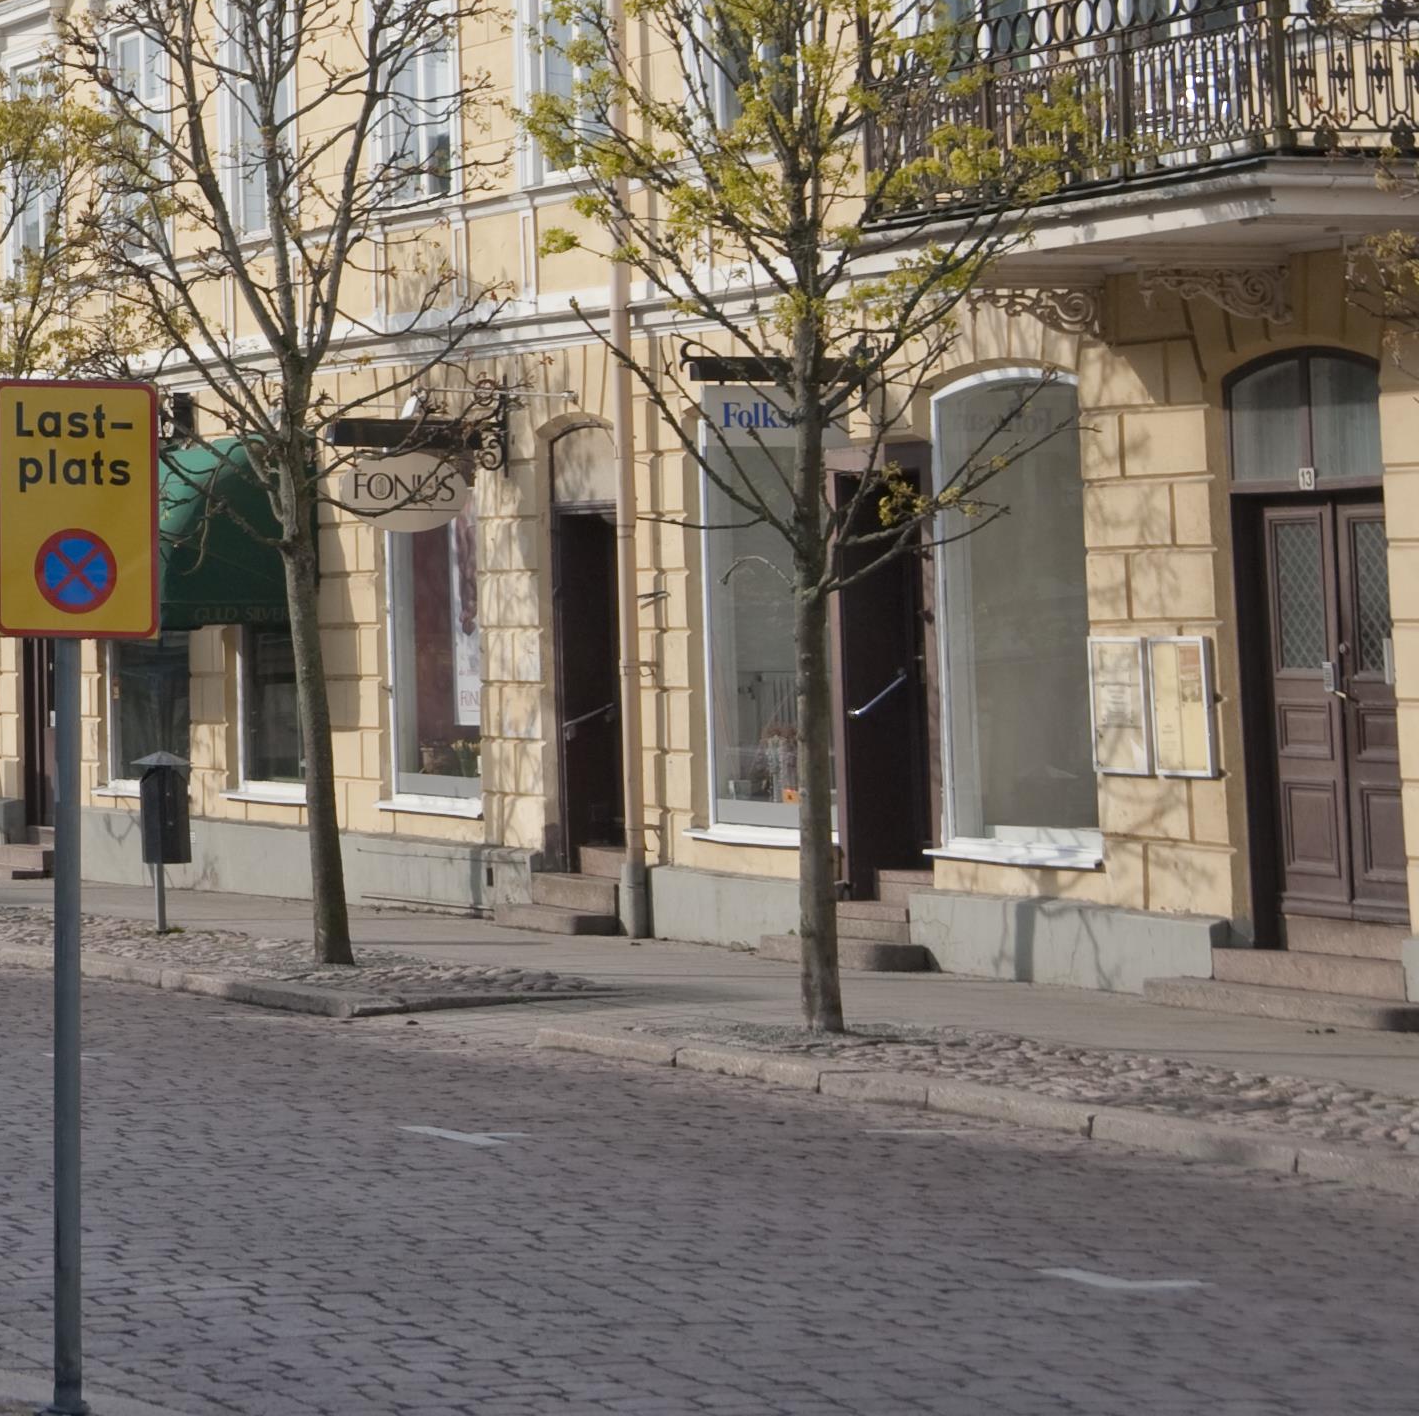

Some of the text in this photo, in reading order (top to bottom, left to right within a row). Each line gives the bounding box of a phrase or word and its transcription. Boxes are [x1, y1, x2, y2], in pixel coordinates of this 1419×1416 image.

[16, 401, 133, 439] Last-
[19, 449, 131, 493] plats
[353, 472, 456, 502] FONUS
[1301, 470, 1313, 488] 13
